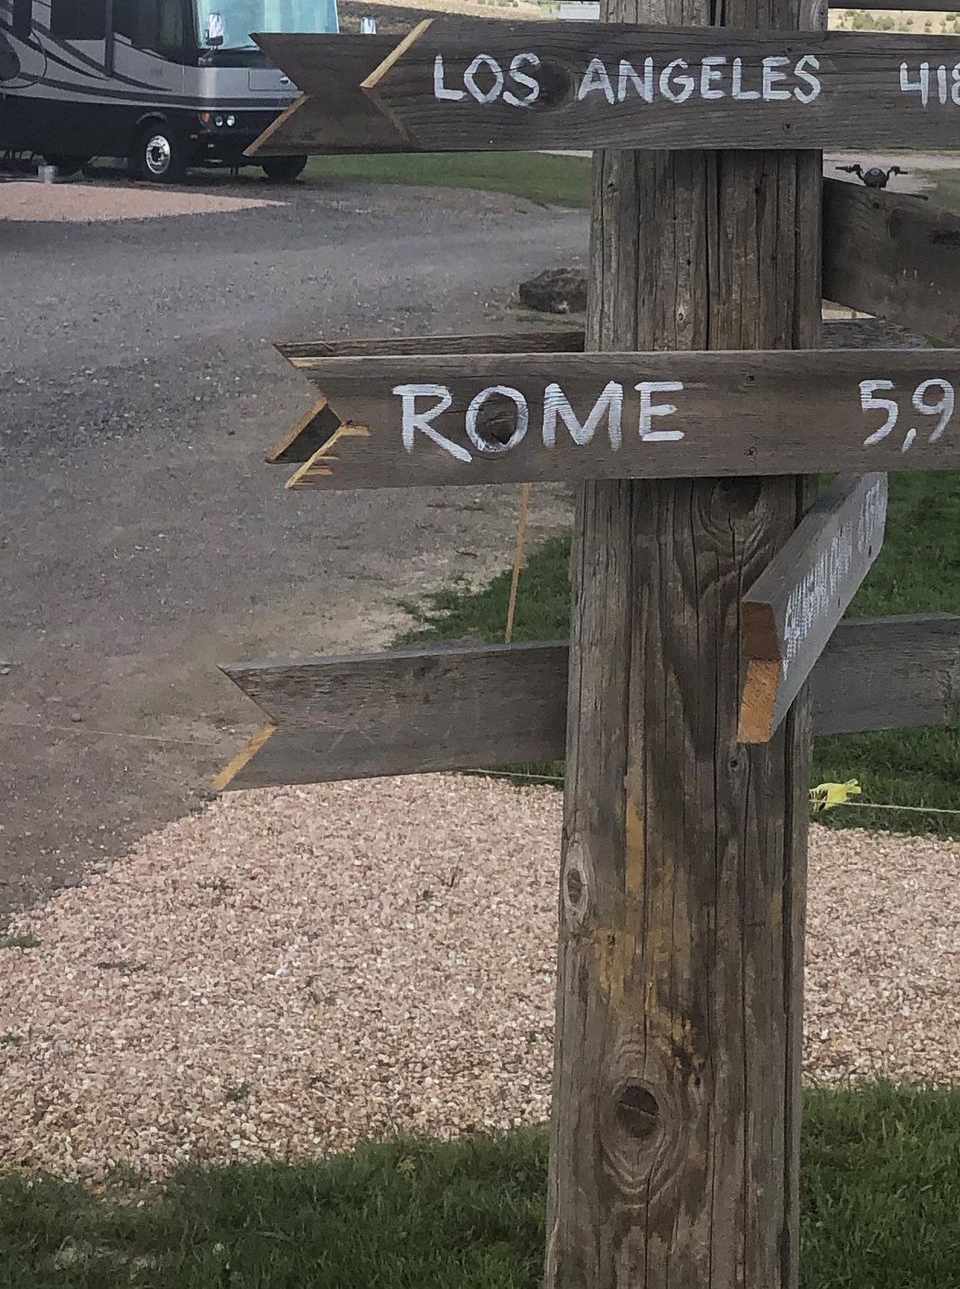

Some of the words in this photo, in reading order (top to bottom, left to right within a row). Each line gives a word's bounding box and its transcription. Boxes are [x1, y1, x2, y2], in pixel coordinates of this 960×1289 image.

[434, 53, 541, 108] LOS
[576, 54, 823, 105] ANGELES
[392, 380, 685, 463] ROME
